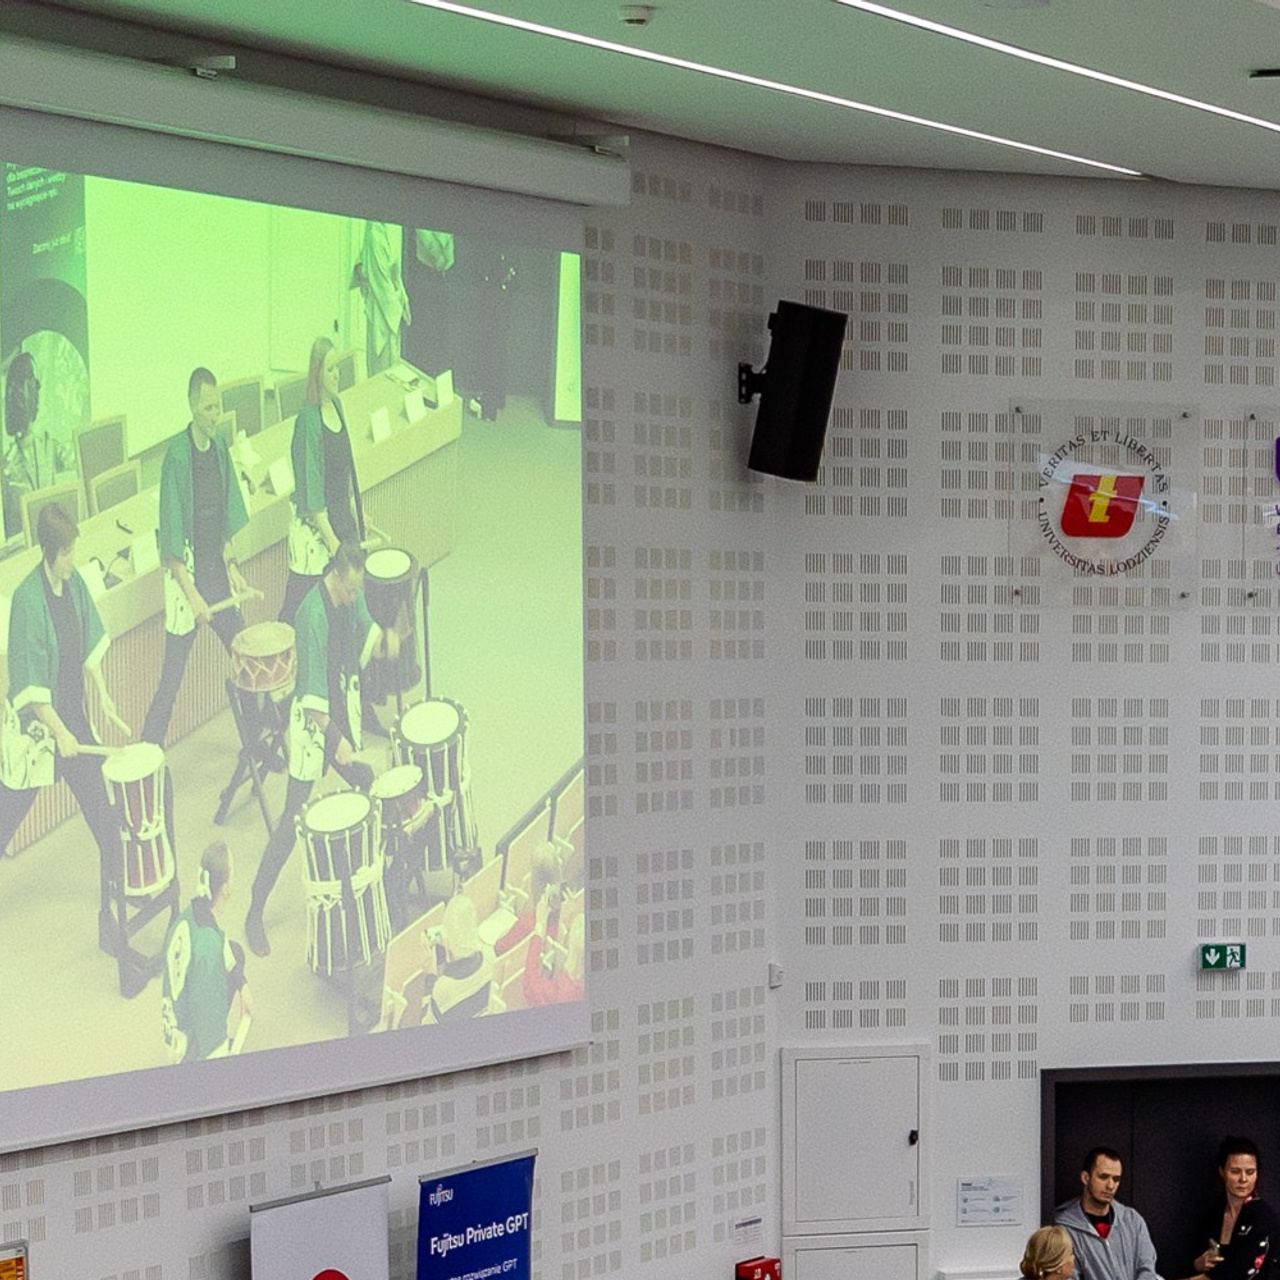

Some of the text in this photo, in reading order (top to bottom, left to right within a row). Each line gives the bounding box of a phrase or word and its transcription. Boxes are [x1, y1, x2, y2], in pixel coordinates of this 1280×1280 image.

[1040, 430, 1169, 493] VERITAS ET LIBERTAS
[1038, 510, 1171, 576] UNIVERSITAS LODZIENSIS
[430, 1212, 529, 1258] Fujitsu Private GPT
[502, 1258, 518, 1272] GPT
